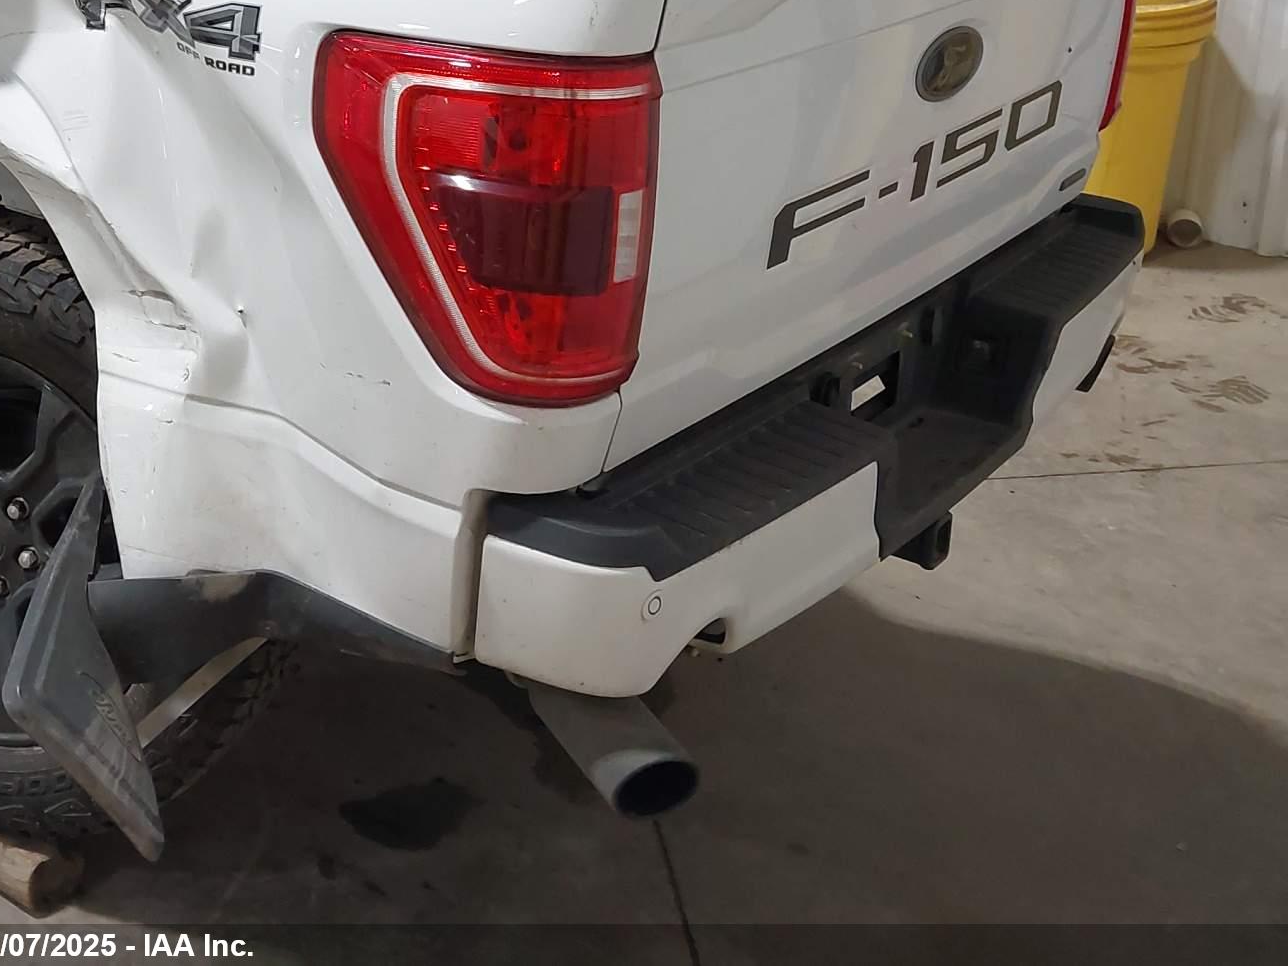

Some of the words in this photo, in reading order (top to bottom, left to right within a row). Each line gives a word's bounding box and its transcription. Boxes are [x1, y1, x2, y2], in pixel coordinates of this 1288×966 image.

[176, 41, 200, 60] OFF
[204, 56, 256, 77] ROAD
[766, 80, 1063, 270] F-150
